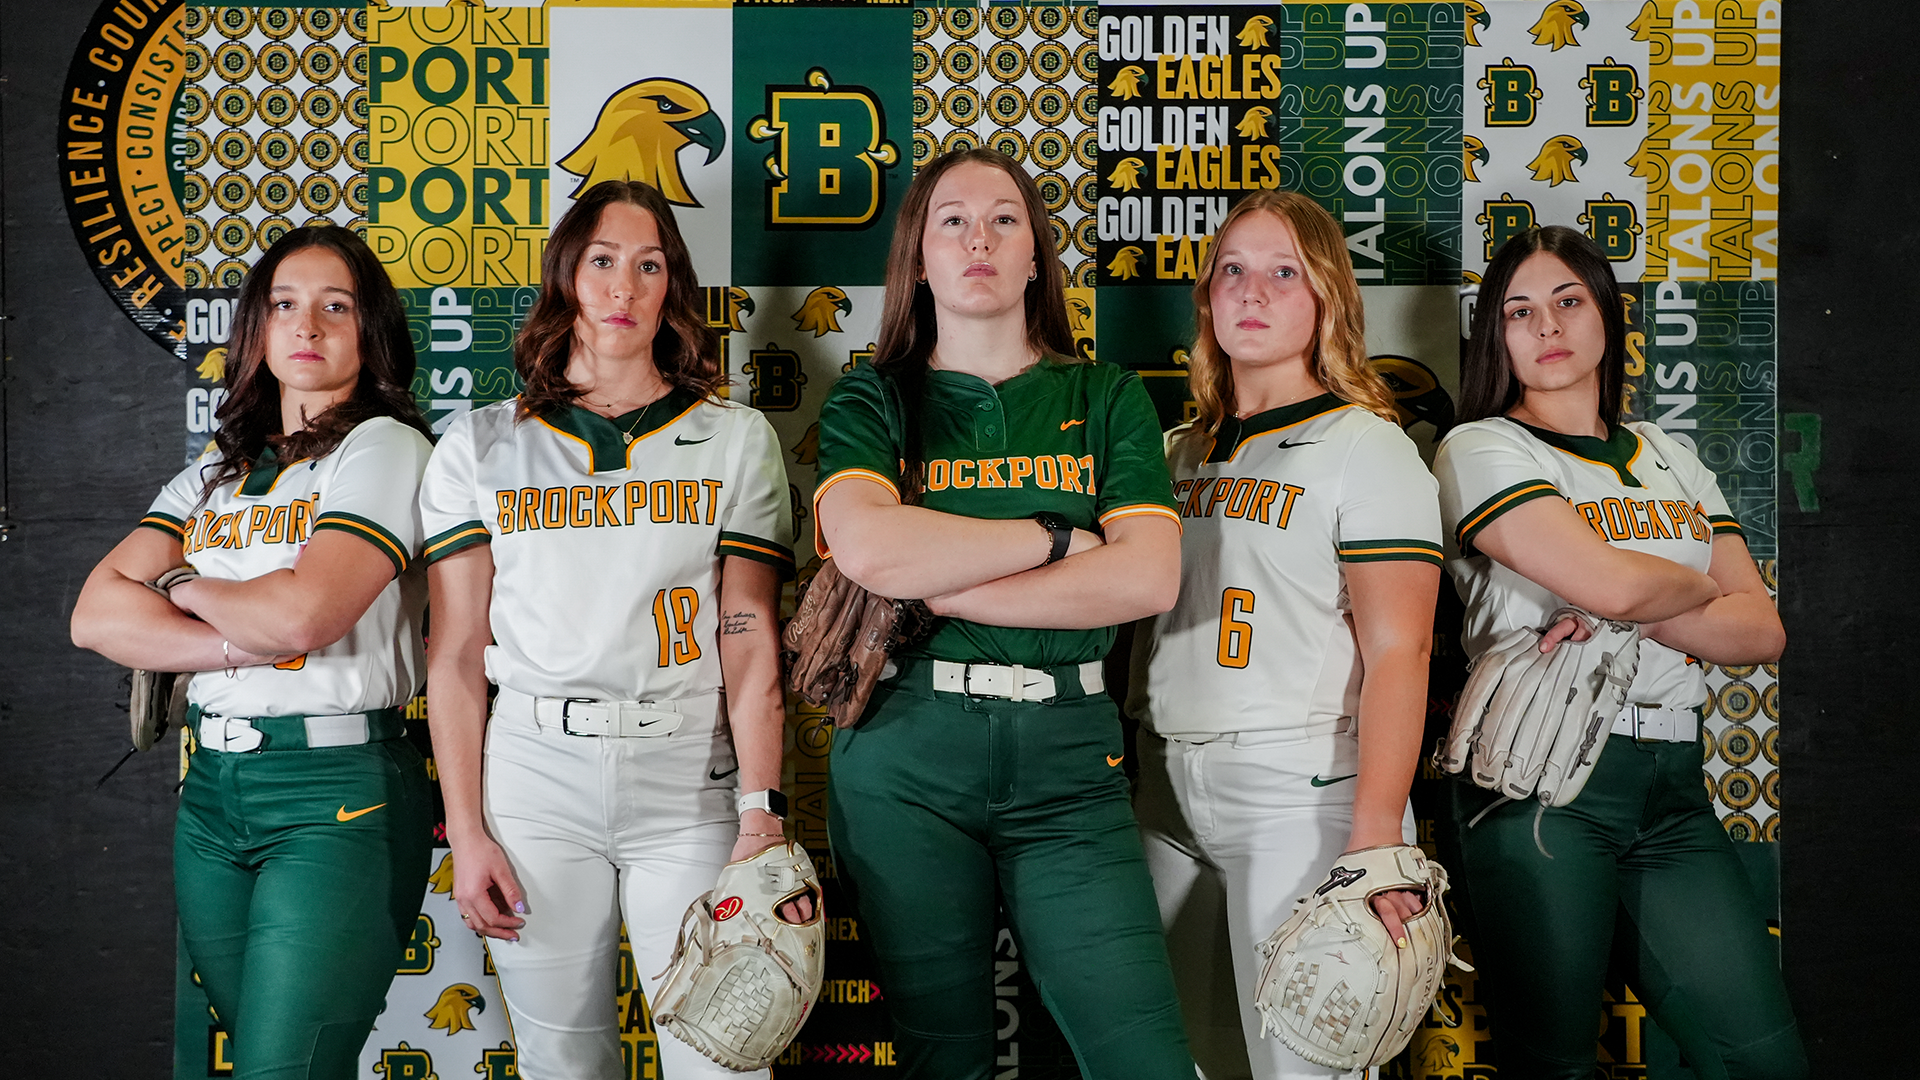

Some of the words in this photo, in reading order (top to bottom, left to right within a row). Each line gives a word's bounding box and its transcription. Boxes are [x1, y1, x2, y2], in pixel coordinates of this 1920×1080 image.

[1099, 15, 1230, 61] GOLDEN
[1303, 3, 1345, 69] UP
[1344, 3, 1387, 69] UP
[1386, 3, 1428, 69] UP
[1427, 3, 1464, 69] UP
[1672, 0, 1715, 66] UP
[1714, 0, 1757, 66] UP
[369, 46, 549, 105] PORT
[1157, 54, 1281, 100] EAGLES
[1485, 64, 1537, 127] B
[1586, 64, 1638, 127] B
[368, 105, 549, 165] PORT
[765, 84, 887, 231] B
[1098, 106, 1229, 152] GOLDEN
[67, 87, 164, 309] RESILIENCE
[368, 166, 549, 225] PORT
[1156, 144, 1281, 190] EAGLES
[1385, 84, 1428, 285] TALONS
[1668, 81, 1713, 281] TALONS
[1709, 80, 1756, 280] TALONS
[1097, 196, 1228, 241] GOLDEN
[1585, 200, 1637, 262] B
[367, 225, 549, 286] PORT
[430, 287, 473, 352] UP
[472, 287, 514, 352] UP
[1655, 281, 1698, 346] UP
[750, 350, 801, 412] B
[496, 478, 724, 536] BROCKPORT
[651, 586, 702, 668] 19
[1216, 586, 1256, 670] 6
[819, 980, 870, 1003] PITCH
